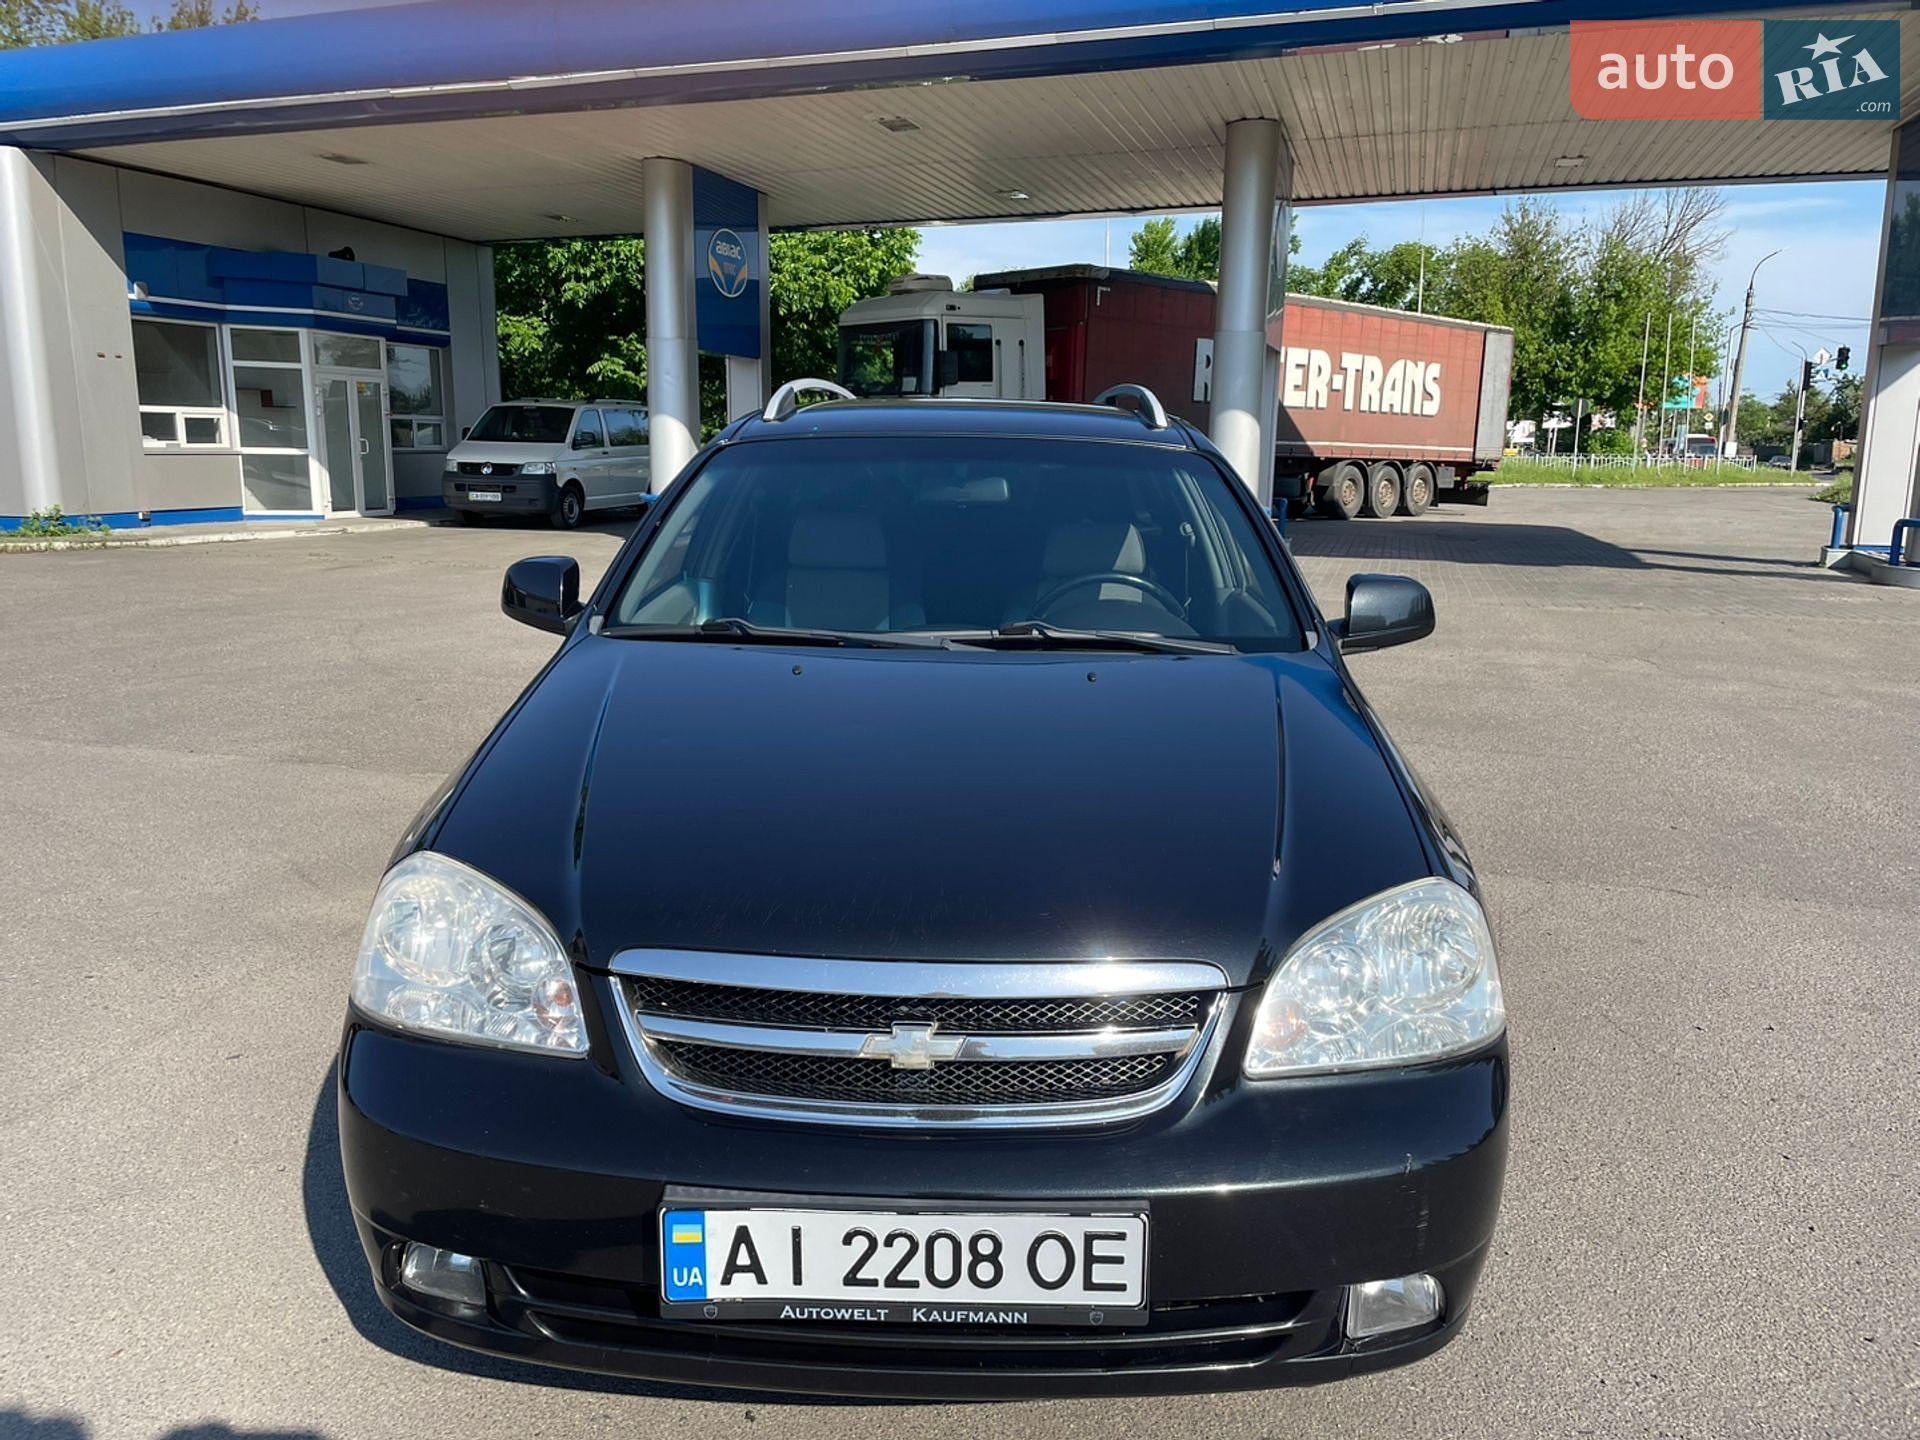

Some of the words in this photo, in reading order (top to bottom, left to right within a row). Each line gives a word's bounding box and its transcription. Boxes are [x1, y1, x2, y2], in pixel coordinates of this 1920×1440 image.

[842, 1226, 1004, 1290] 2208
[1026, 1230, 1128, 1292] OE
[673, 1267, 703, 1287] UA
[912, 1307, 1028, 1324] KAUFMANN
